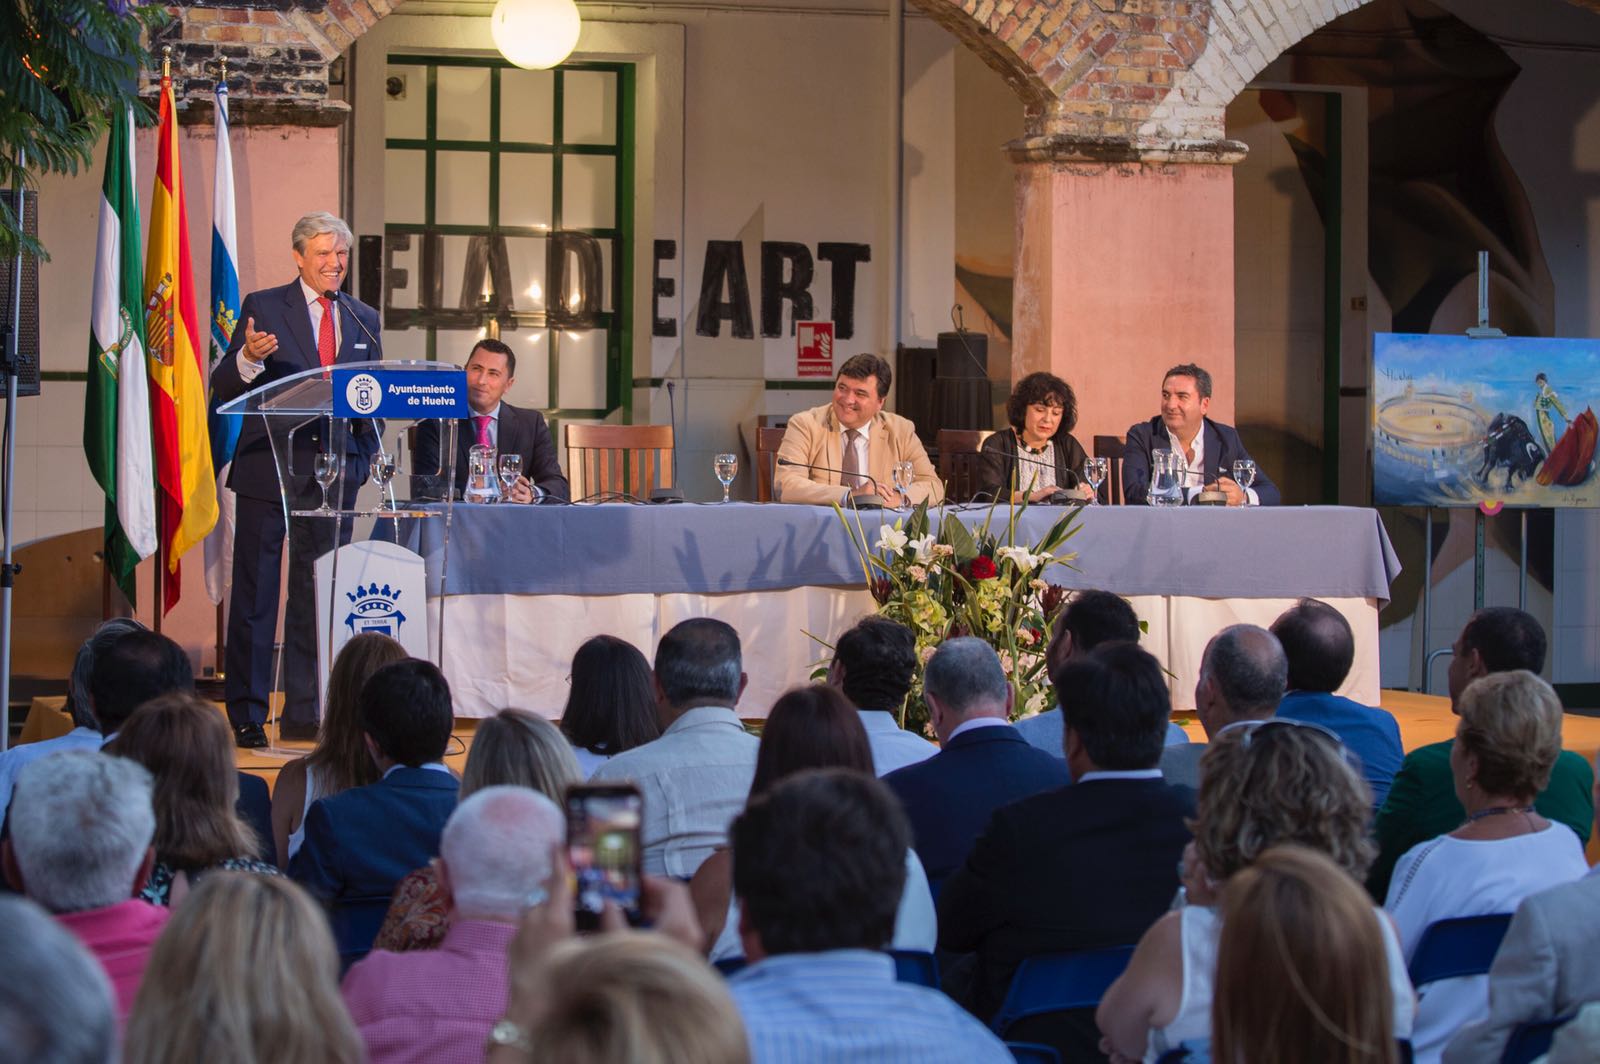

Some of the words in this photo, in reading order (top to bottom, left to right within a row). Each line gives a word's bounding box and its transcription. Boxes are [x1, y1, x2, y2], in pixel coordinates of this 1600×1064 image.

[696, 240, 871, 340] ART
[388, 384, 455, 395] Ayuntamiento
[407, 396, 419, 406] de
[422, 396, 455, 406] Huelva
